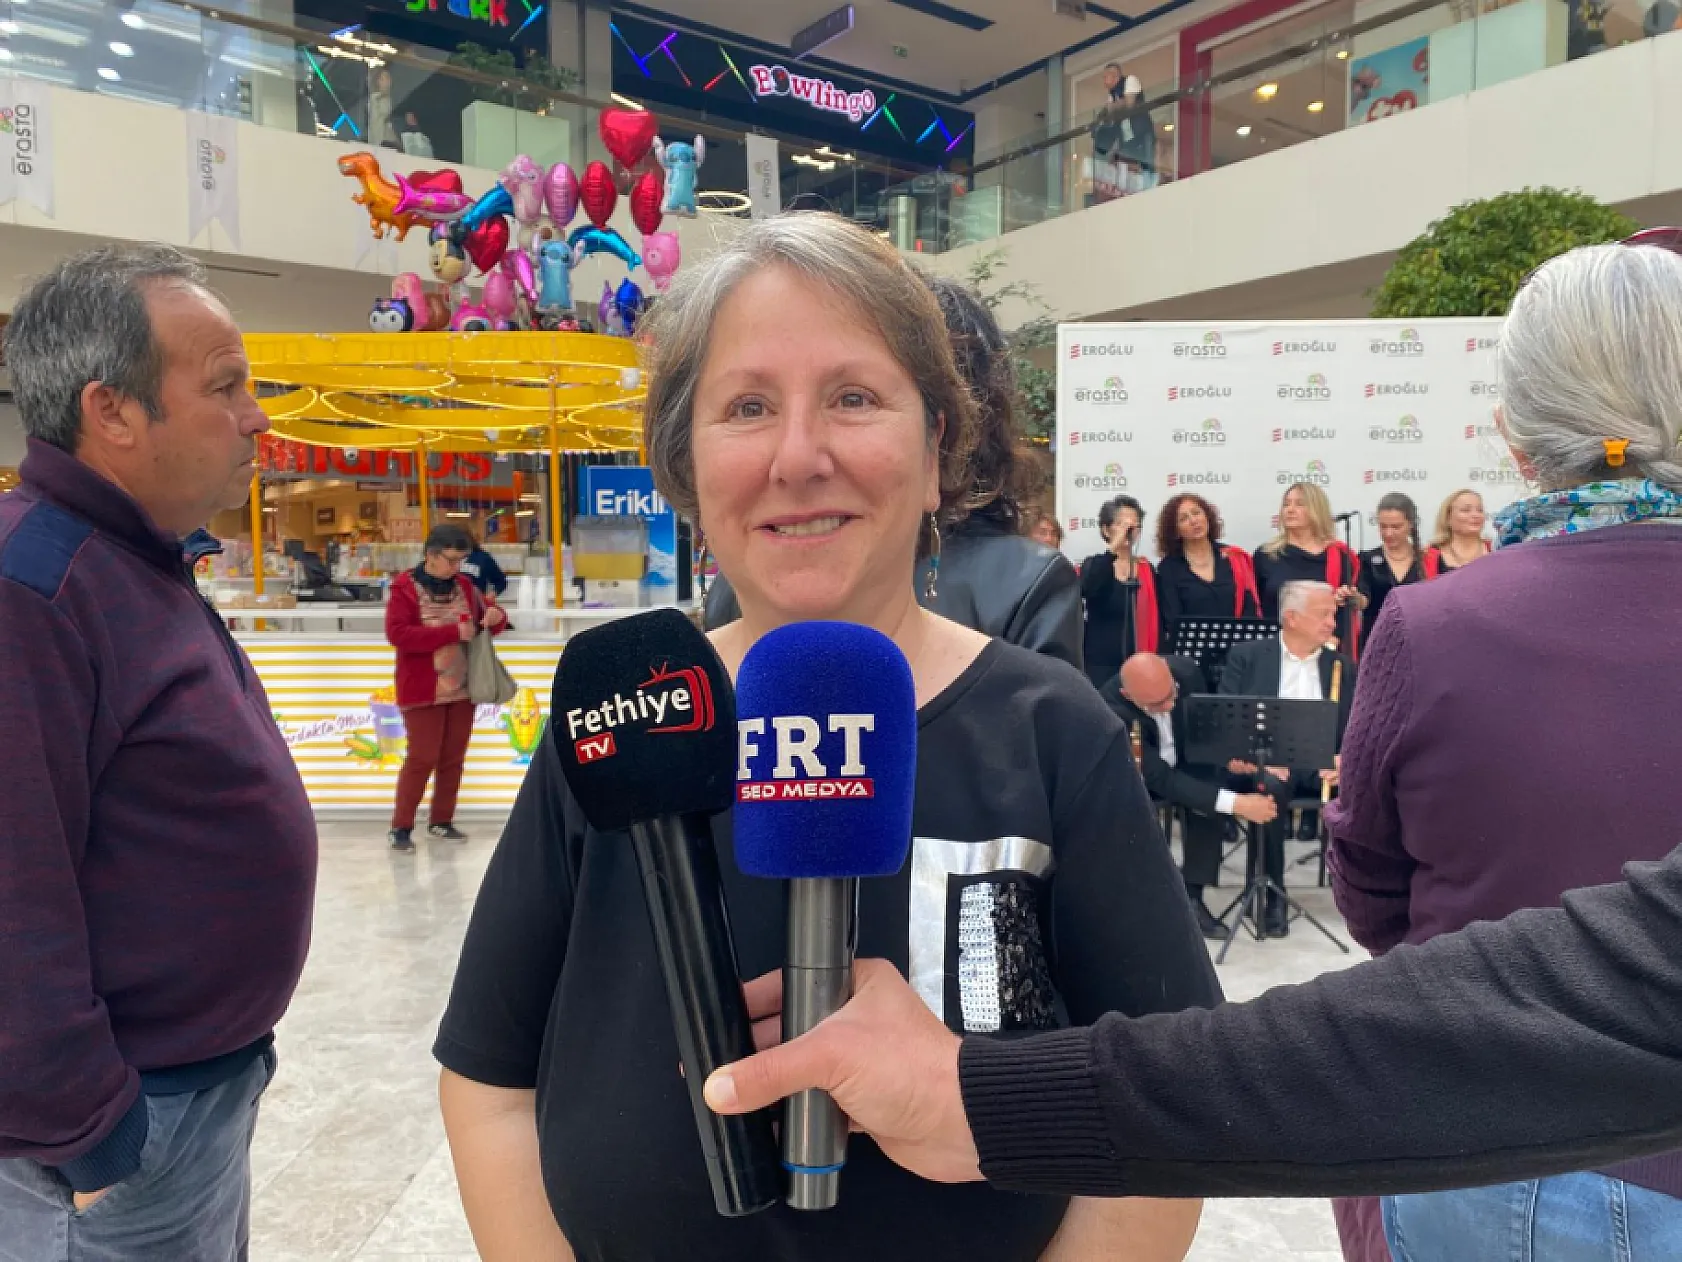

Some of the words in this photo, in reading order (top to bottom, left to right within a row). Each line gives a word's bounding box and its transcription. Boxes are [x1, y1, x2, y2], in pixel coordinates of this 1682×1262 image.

[15, 104, 33, 176] erasta
[1082, 343, 1134, 356] EROĞLU
[1284, 340, 1337, 352] EROĞLU
[1179, 385, 1232, 398] EROĞLU
[1376, 381, 1429, 394] EROĞLU
[1082, 429, 1133, 442] EROĞLU
[1284, 426, 1336, 439] EROĞLU
[1179, 471, 1231, 484] EROĞLU
[1376, 468, 1428, 481] EROĞLU
[566, 686, 692, 740] Fethiye
[580, 737, 611, 760] TV
[737, 713, 875, 780] FRT
[741, 784, 776, 800] SED
[781, 781, 869, 798] MEDYA
